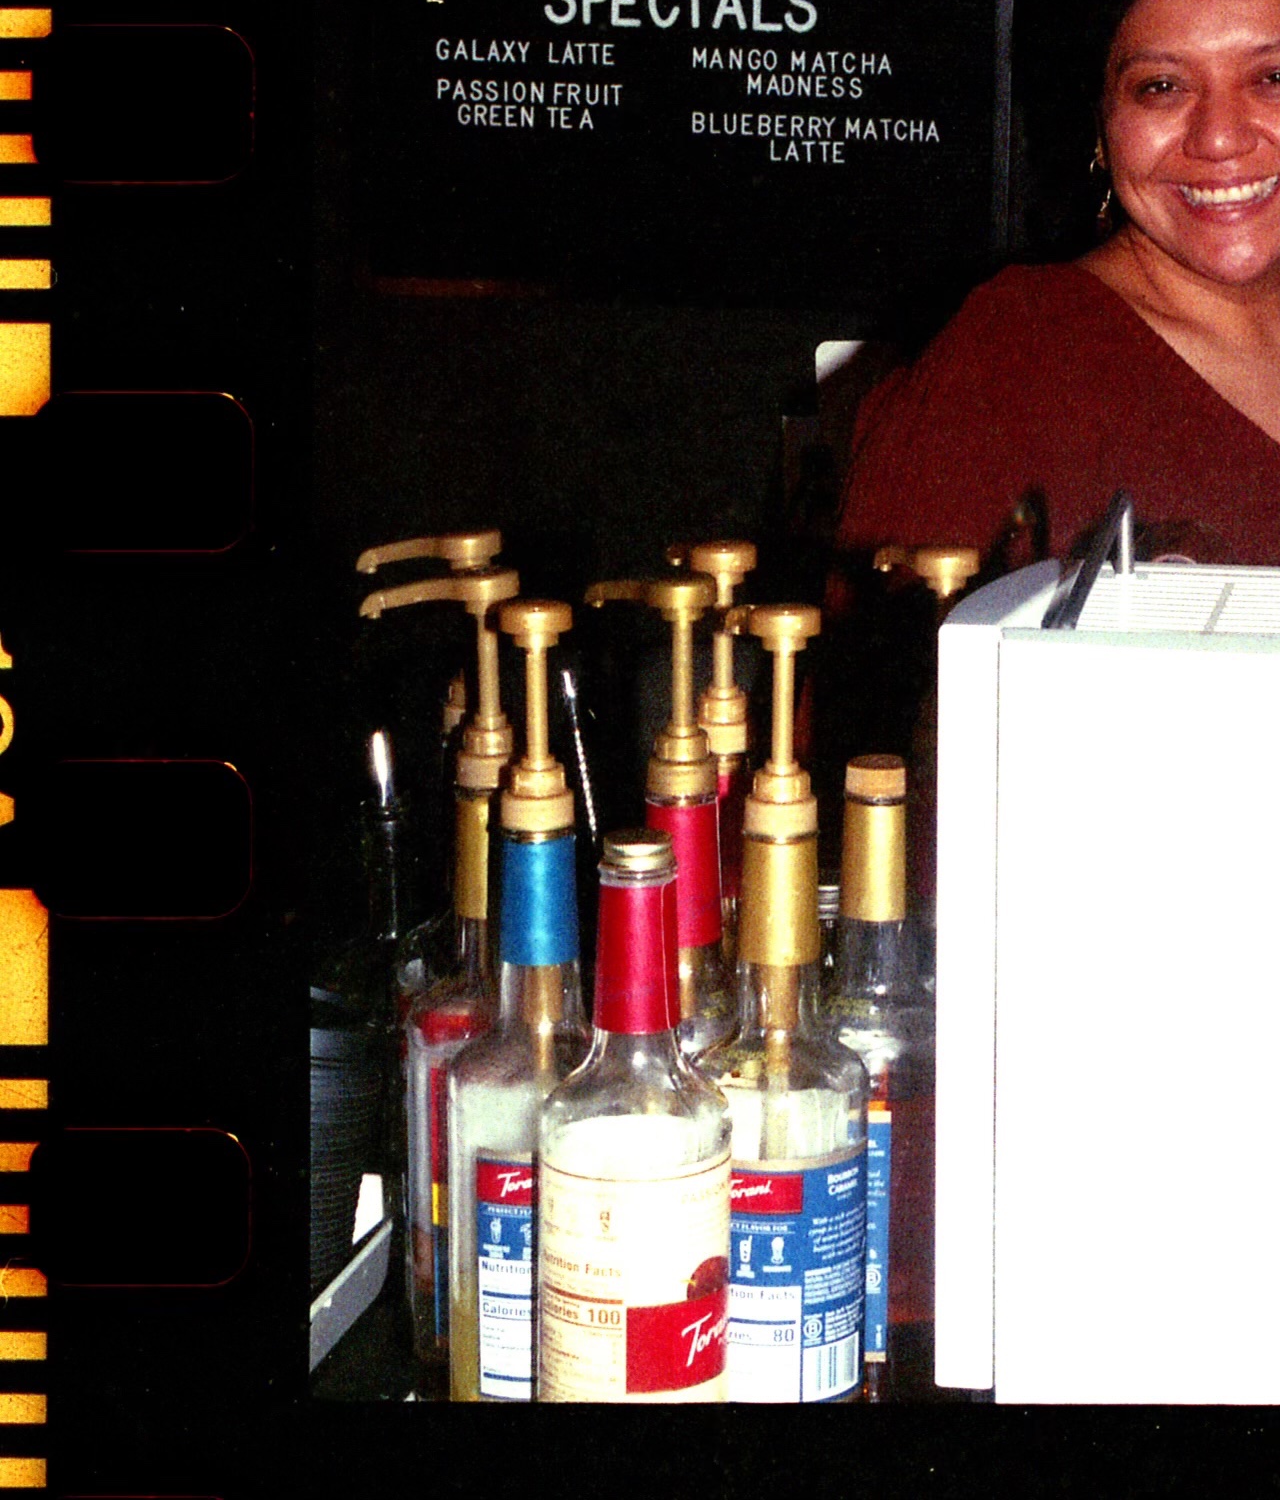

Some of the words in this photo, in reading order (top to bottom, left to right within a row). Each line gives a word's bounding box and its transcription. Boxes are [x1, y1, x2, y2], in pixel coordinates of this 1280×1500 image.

[436, 39, 530, 63] GALAXY
[548, 41, 615, 66] LATTE
[692, 47, 778, 72] MANGO
[790, 51, 892, 76] MATCHA
[437, 79, 544, 104] PASSION
[554, 83, 623, 106] FRUIT
[747, 75, 863, 99] MADNESS
[458, 104, 535, 128] GREEN
[547, 107, 594, 130] TEA
[692, 112, 836, 138] BLUEBERRY
[845, 118, 940, 143] MATCHA
[770, 140, 845, 164] LATTE
[497, 1171, 532, 1198] Tora
[585, 1263, 621, 1278] Facts
[587, 1308, 621, 1326] 100
[773, 1329, 795, 1342] 80
